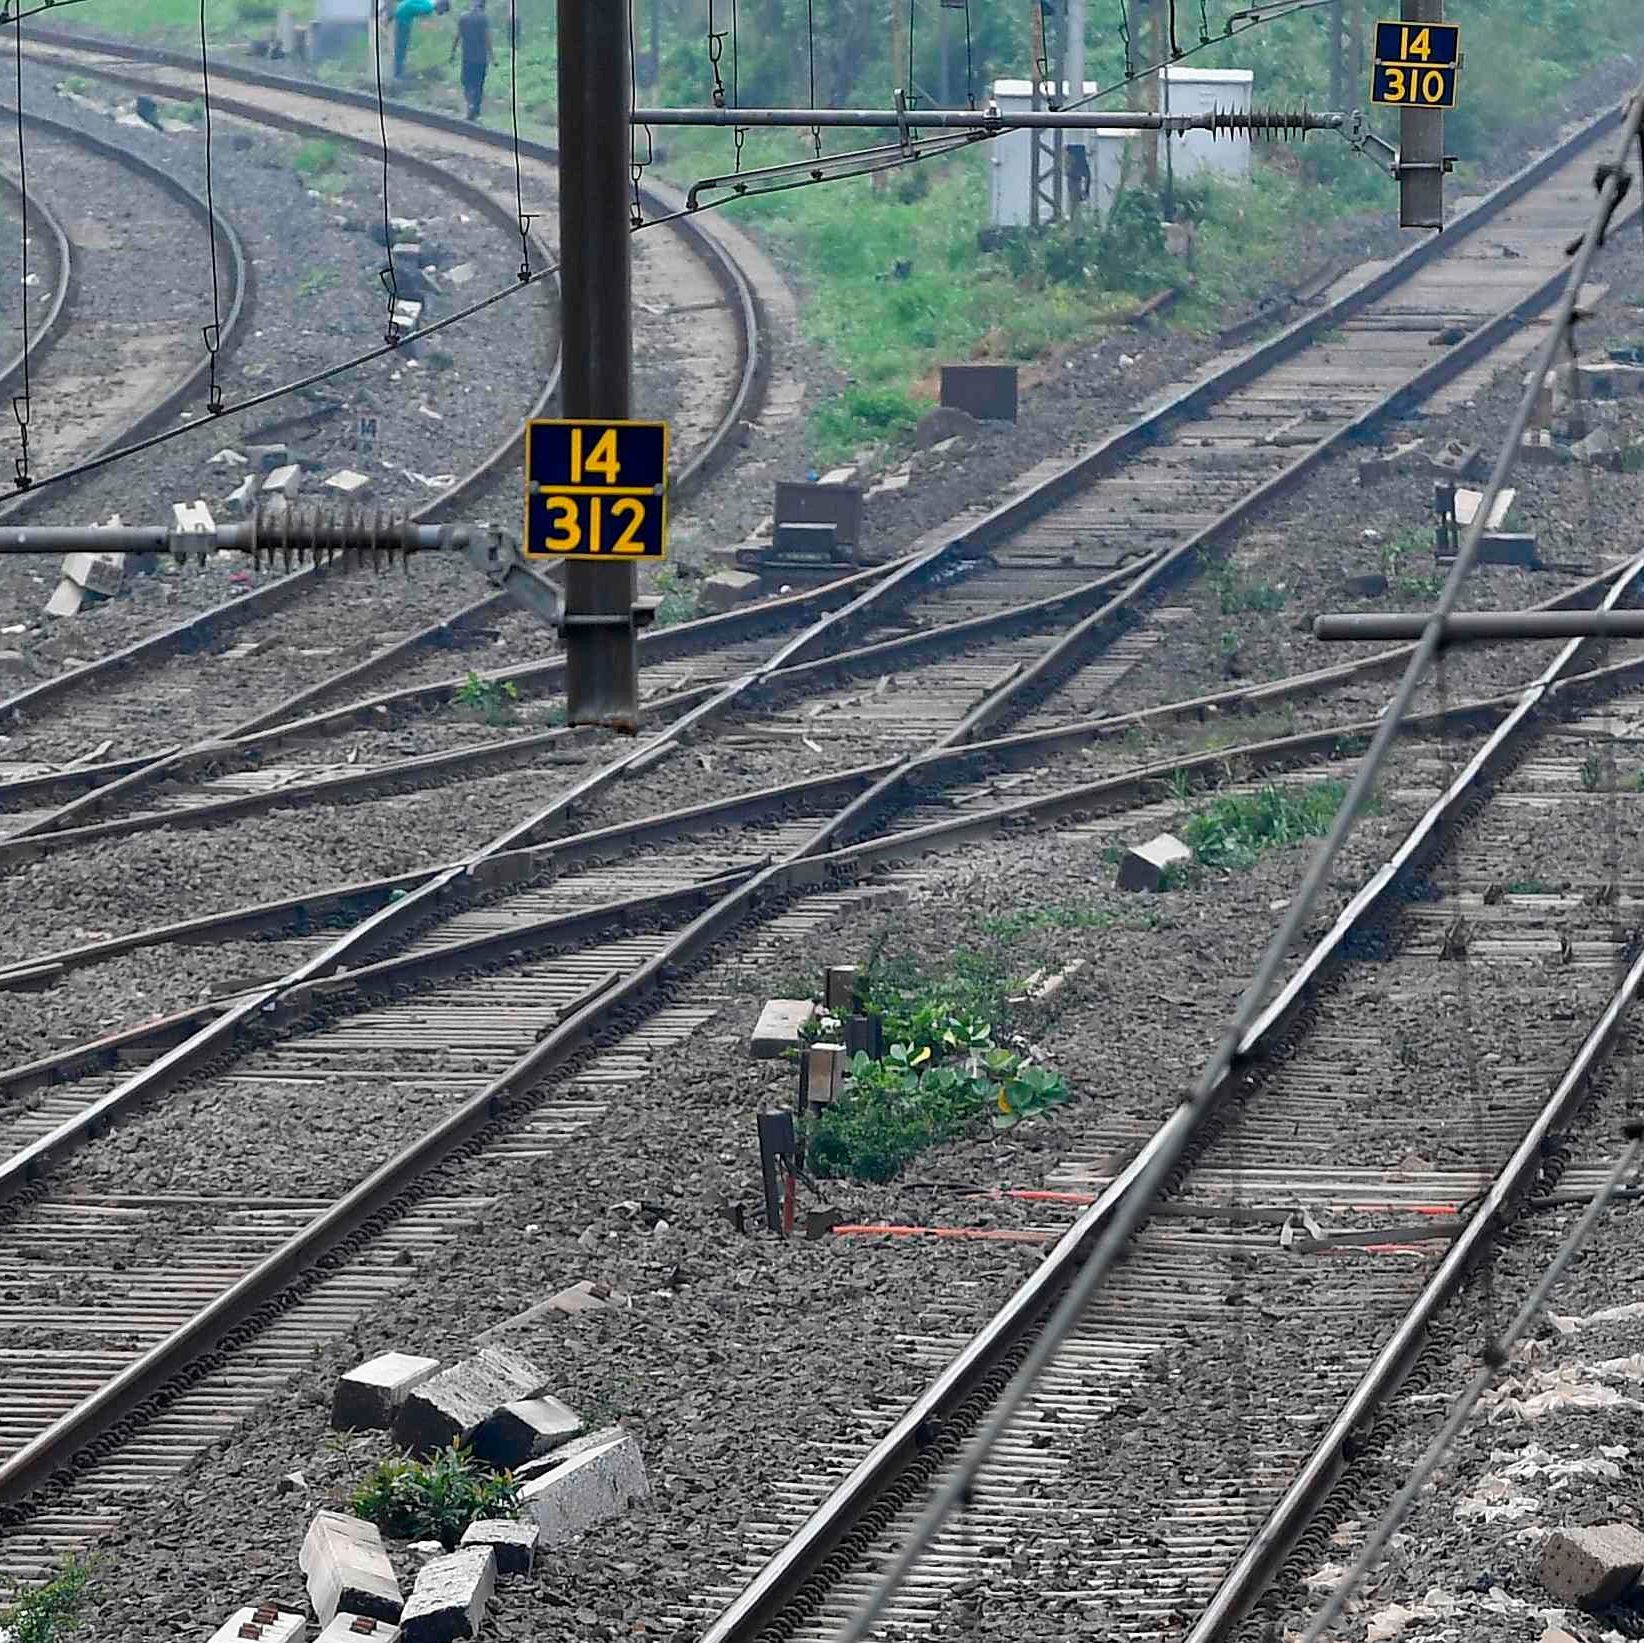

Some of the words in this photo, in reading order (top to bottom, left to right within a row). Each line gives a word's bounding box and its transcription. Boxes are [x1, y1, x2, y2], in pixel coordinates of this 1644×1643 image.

[1400, 27, 1431, 61] 14
[1384, 68, 1444, 103] 310
[570, 428, 621, 484] 14
[545, 496, 646, 553] 312
